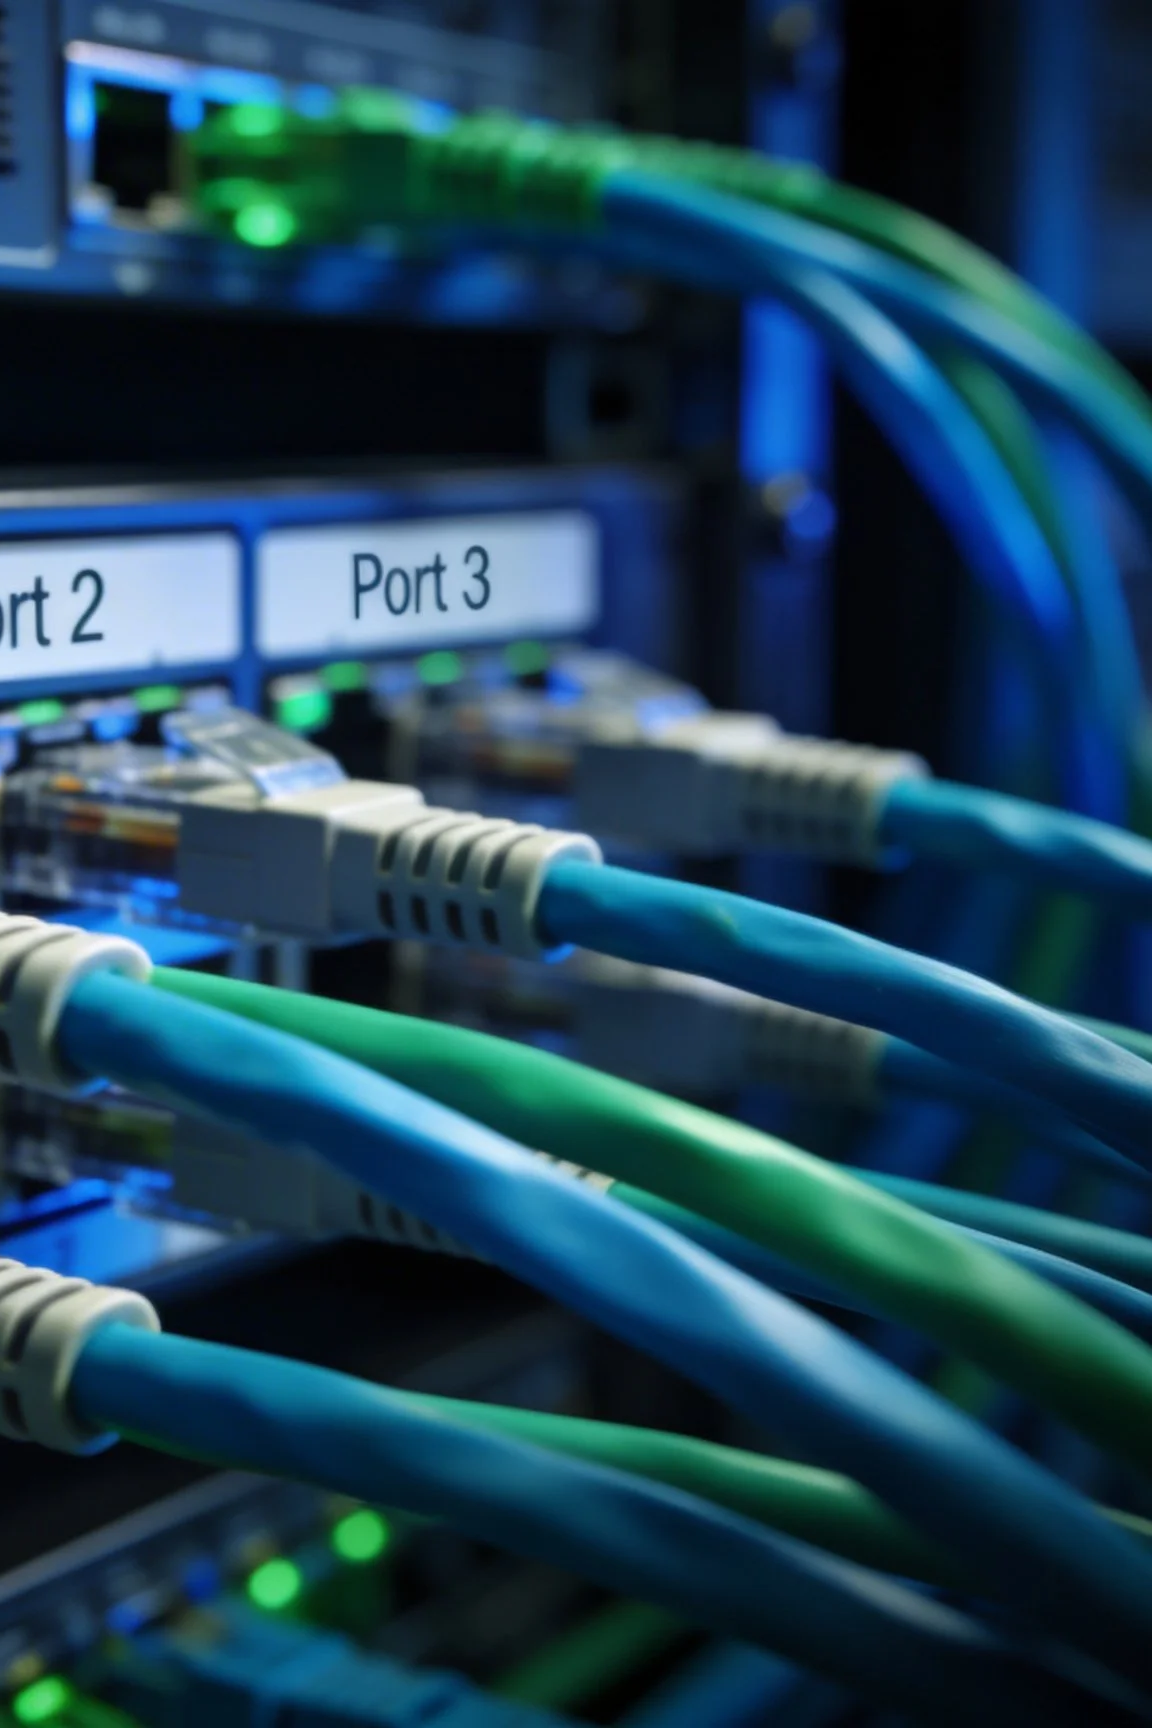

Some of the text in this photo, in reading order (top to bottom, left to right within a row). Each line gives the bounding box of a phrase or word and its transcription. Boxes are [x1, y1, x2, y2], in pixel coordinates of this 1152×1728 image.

[69, 568, 105, 644] 2
[350, 545, 492, 621] Port 3
